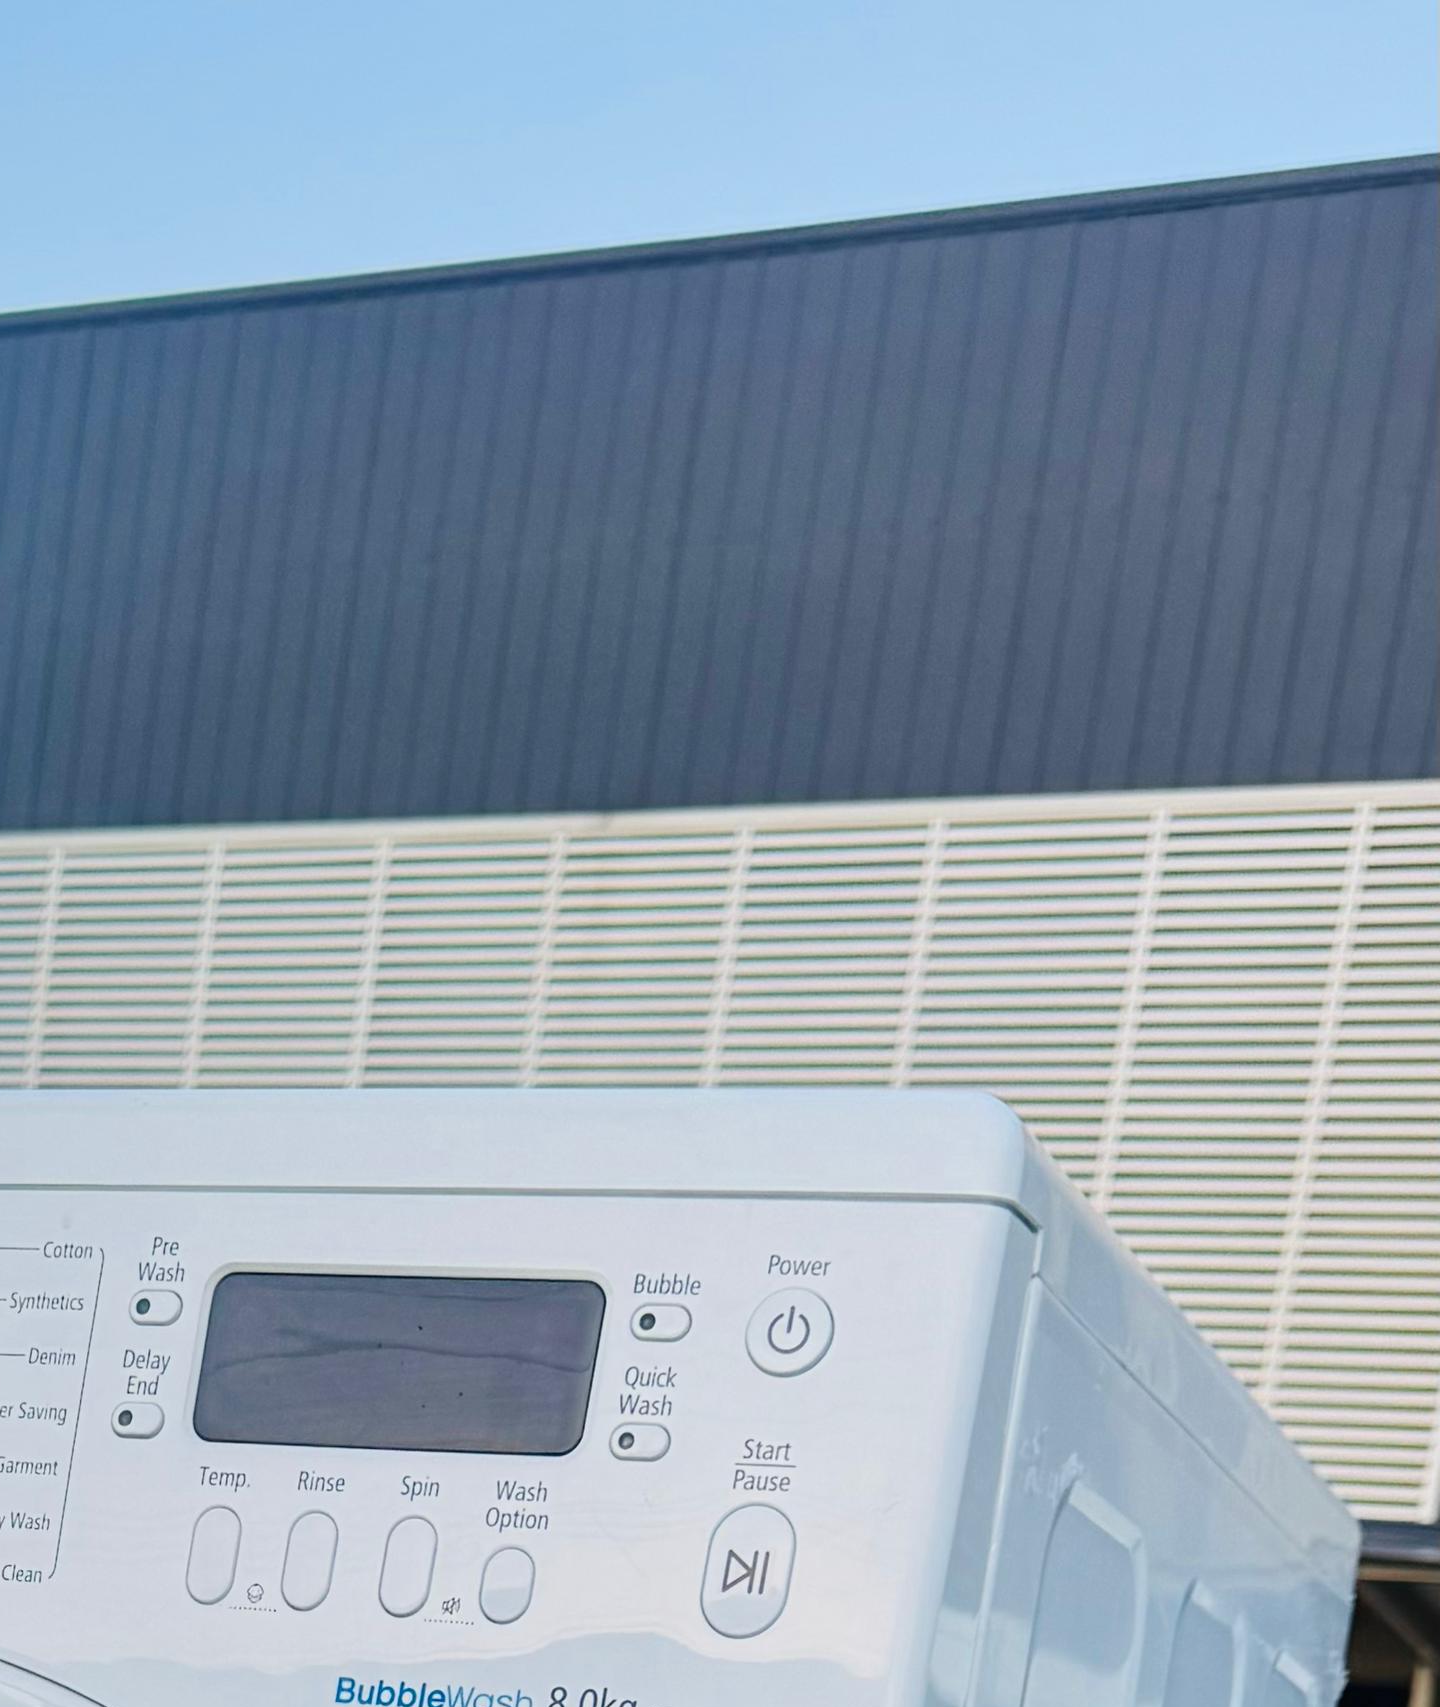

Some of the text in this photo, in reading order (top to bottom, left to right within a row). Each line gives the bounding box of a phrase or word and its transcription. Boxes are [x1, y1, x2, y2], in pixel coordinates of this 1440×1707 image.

[43, 1241, 93, 1259] Cotton
[152, 1236, 179, 1256] Pre
[138, 1262, 185, 1282] Wash
[767, 1254, 831, 1276] Power
[633, 1273, 701, 1295] Bubble
[10, 1292, 84, 1314] Synthetics
[28, 1347, 76, 1366] Denim
[123, 1349, 171, 1375] Delay
[127, 1376, 159, 1396] End
[624, 1366, 678, 1390] Quick
[18, 1402, 67, 1426] Saving
[619, 1394, 673, 1416] Wash
[743, 1438, 791, 1461] Start
[199, 1466, 251, 1490] Temp.
[298, 1470, 345, 1492] Rinse
[400, 1476, 440, 1500] Spin
[732, 1469, 791, 1492] Pause
[496, 1480, 548, 1502] Wash
[10, 1512, 51, 1531] Wash
[485, 1507, 549, 1533] Option
[2, 1564, 42, 1583] Clean
